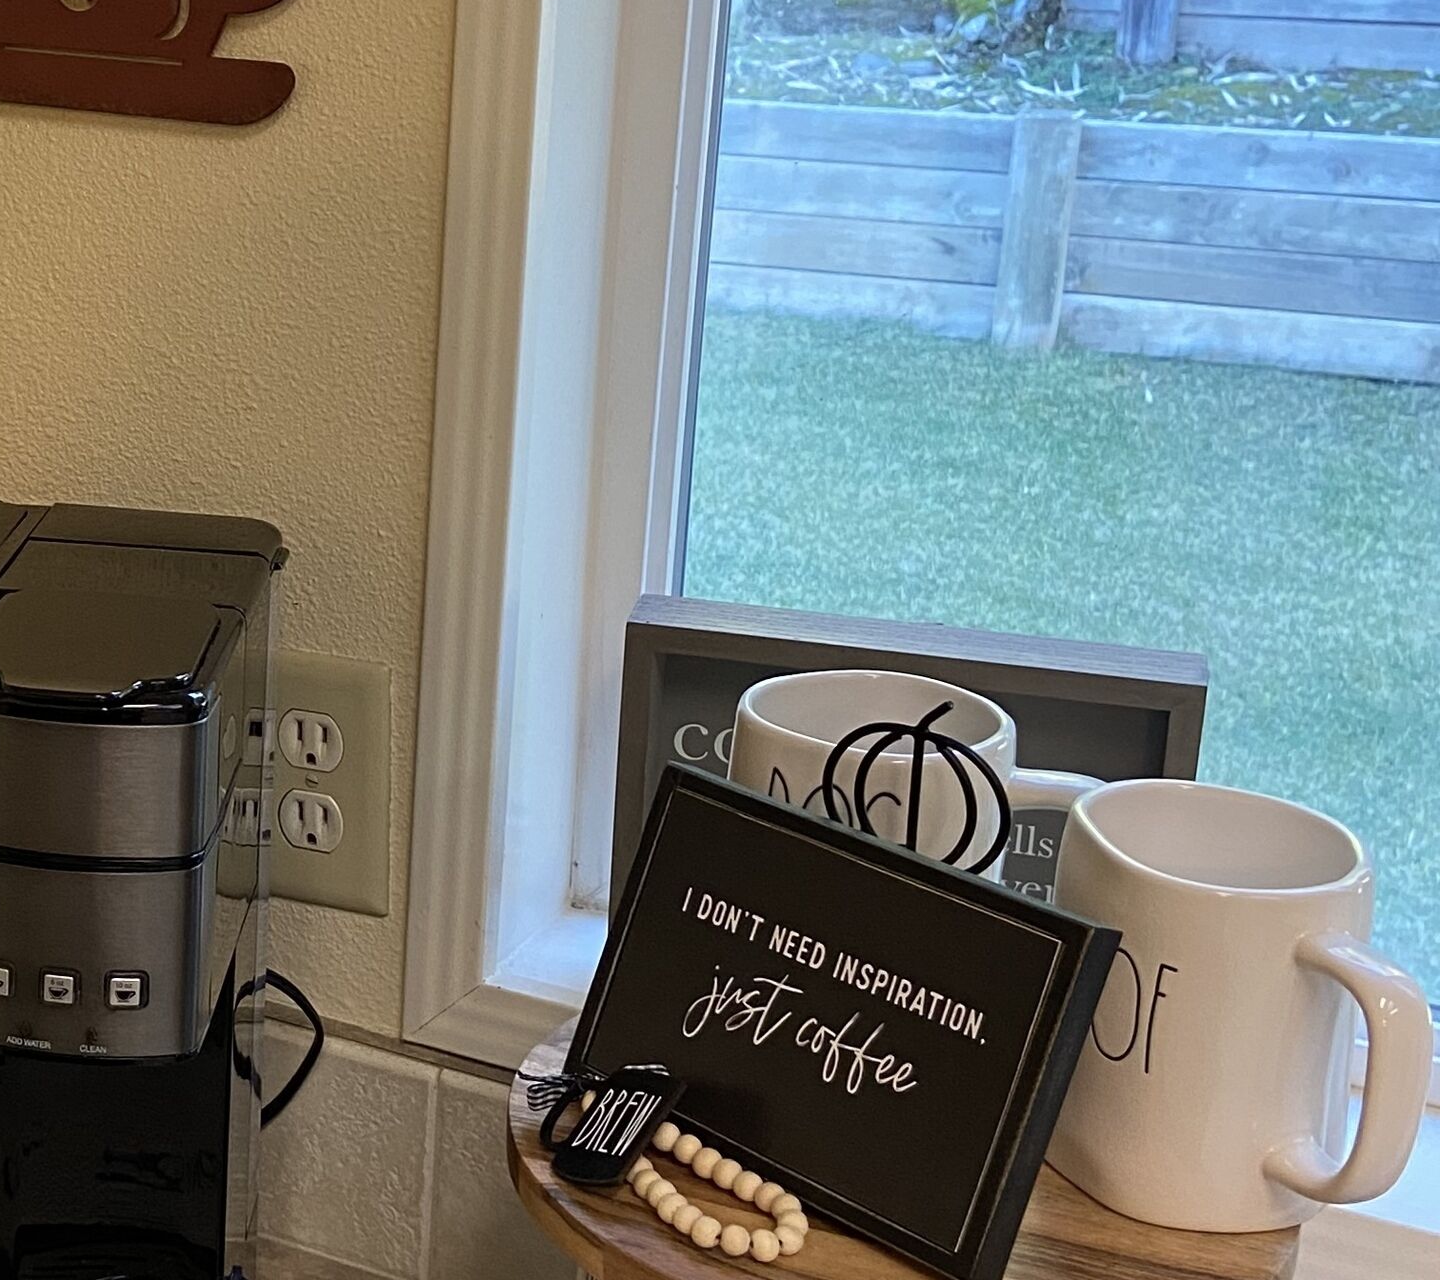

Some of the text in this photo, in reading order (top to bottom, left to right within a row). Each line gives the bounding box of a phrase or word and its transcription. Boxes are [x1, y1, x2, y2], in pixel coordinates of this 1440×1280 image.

[682, 887, 693, 912] I
[697, 893, 765, 941] DON'T
[769, 924, 827, 970] NEED
[6, 1035, 52, 1049] ADD WATER
[682, 964, 918, 1095] just coffee
[1091, 947, 1178, 1074] OF
[79, 1044, 107, 1054] CLEAN
[571, 1088, 662, 1156] BREW
